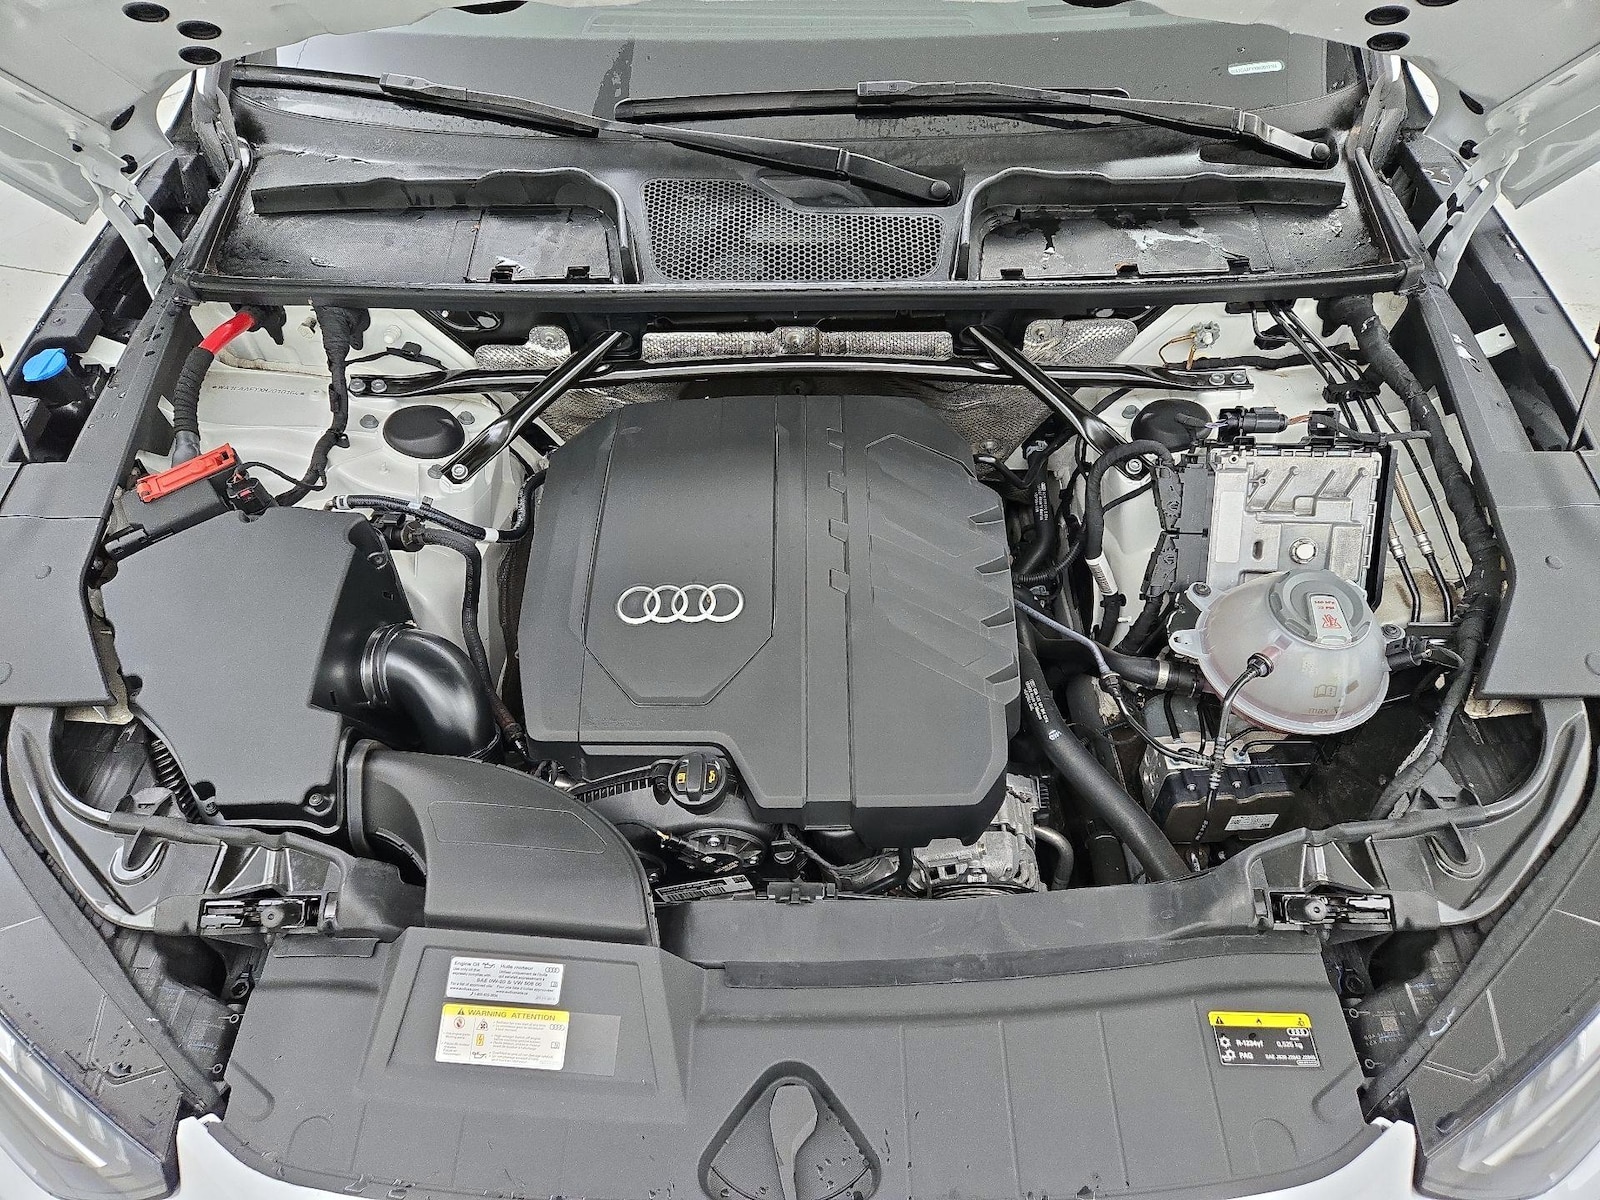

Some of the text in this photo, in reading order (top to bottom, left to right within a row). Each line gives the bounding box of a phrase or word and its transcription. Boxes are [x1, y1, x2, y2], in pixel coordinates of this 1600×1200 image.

[1309, 707, 1328, 715] max
[468, 1009, 556, 1021] WARNING ATTENTION
[1235, 1039, 1263, 1048] R-1234yf
[1294, 1041, 1304, 1050] kg
[1238, 1051, 1254, 1060] PAG
